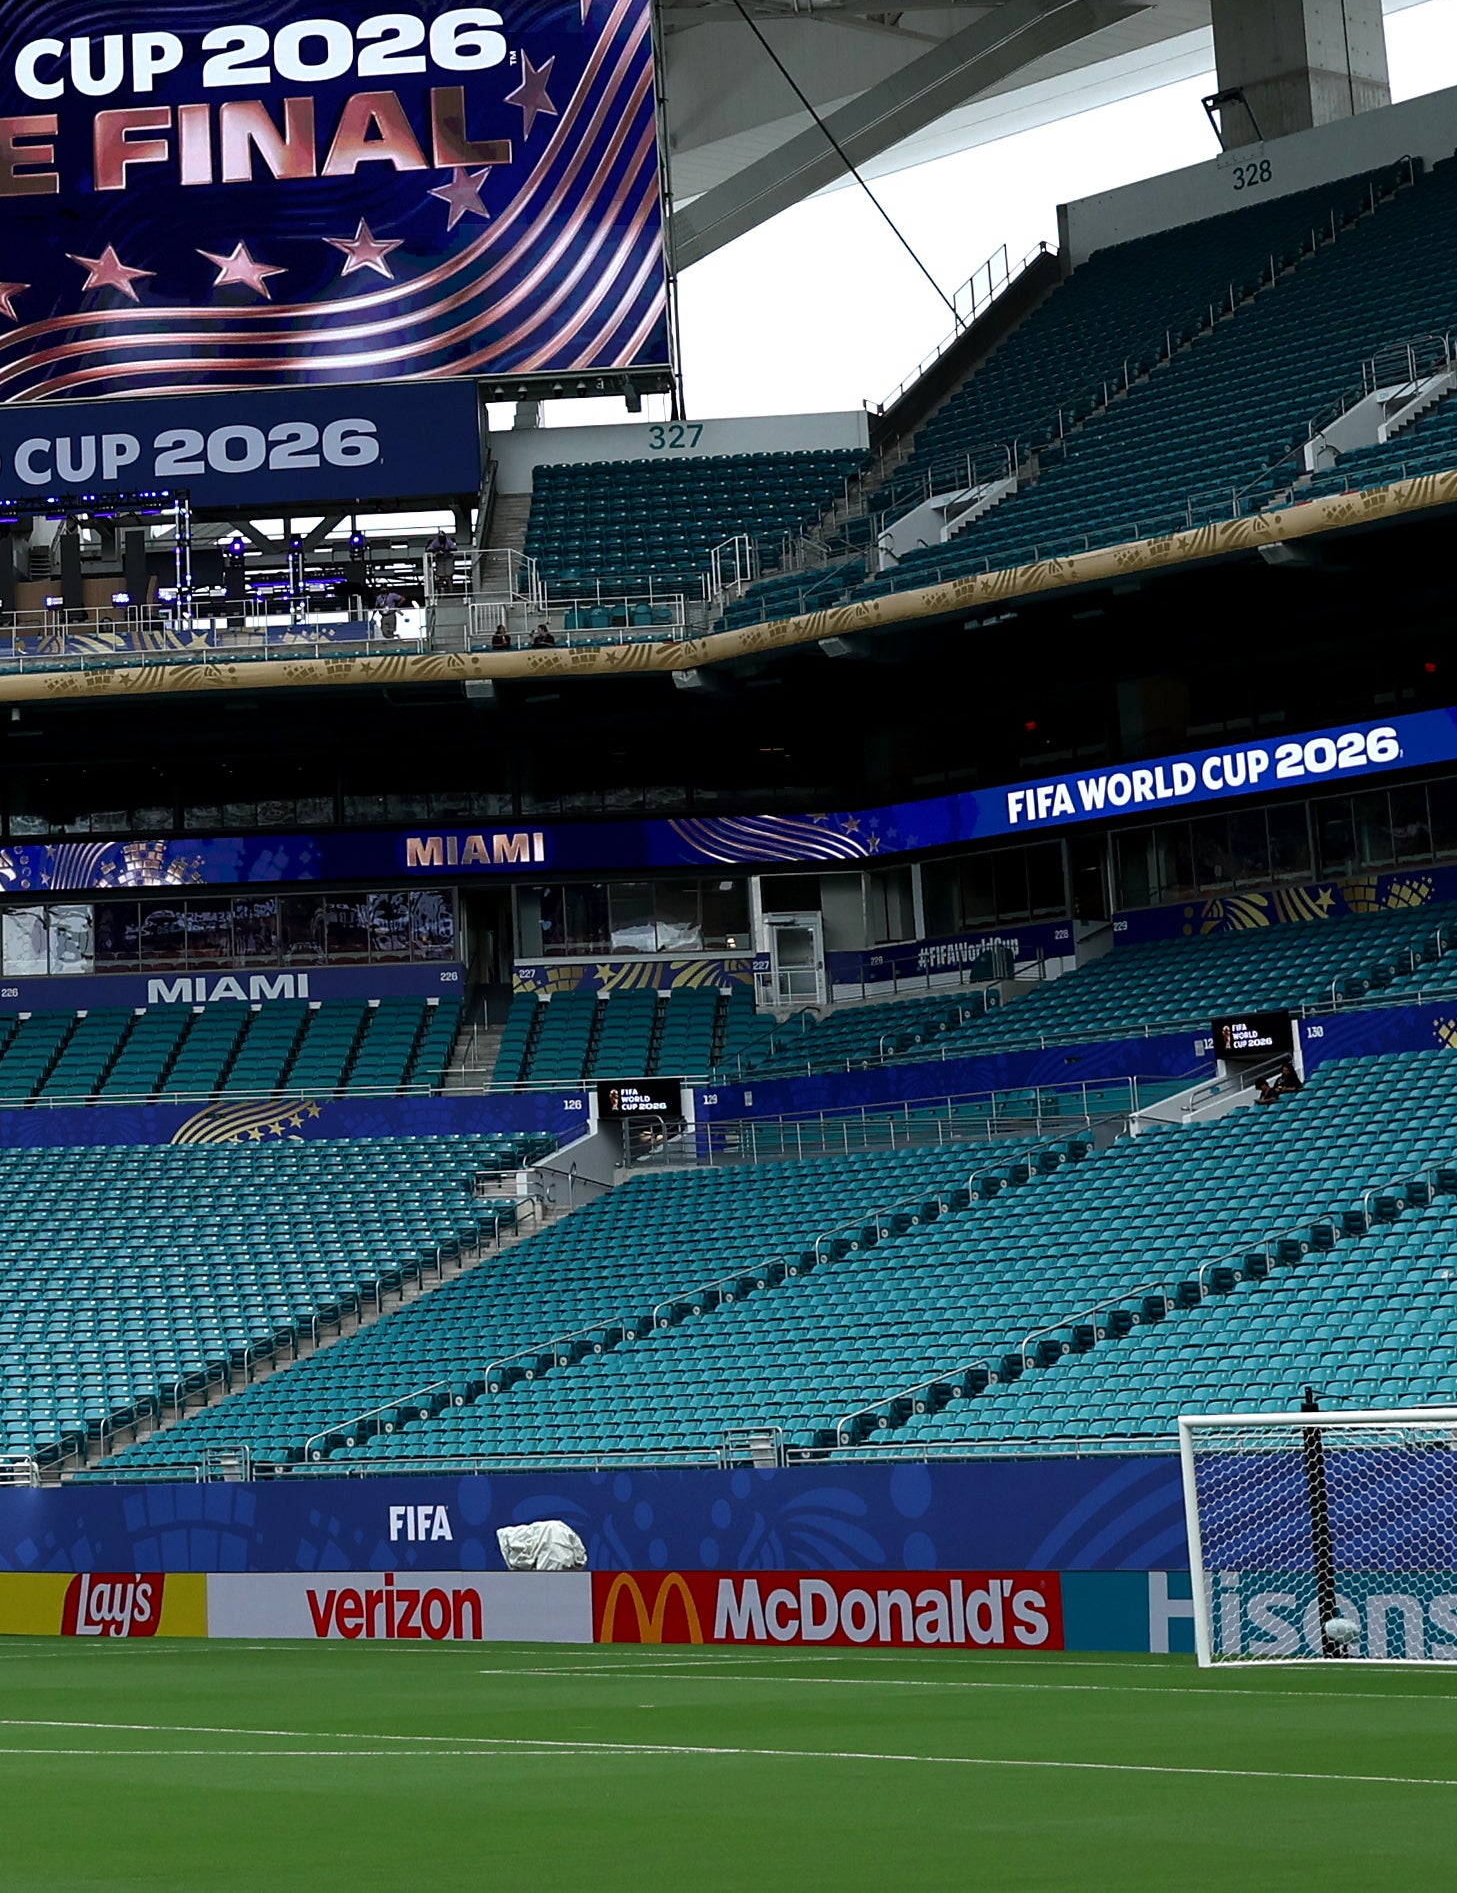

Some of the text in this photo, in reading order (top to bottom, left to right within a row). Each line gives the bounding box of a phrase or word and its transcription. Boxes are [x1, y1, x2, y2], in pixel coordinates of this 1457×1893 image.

[14, 31, 183, 98] CUP
[201, 8, 508, 87] 2026
[94, 85, 512, 191] FINAL
[1232, 160, 1273, 191] 328
[648, 424, 704, 450] 327
[14, 433, 141, 485] CUP
[154, 418, 381, 476] 2026
[1008, 726, 1400, 824] FIFA WORLD CUP 2026
[406, 832, 544, 867] MIAMI
[1054, 929, 1070, 940] 228
[440, 971, 458, 982] 226
[519, 968, 536, 980] 227
[752, 960, 770, 971] 227
[1, 987, 19, 998] 226
[147, 973, 309, 1003] MIAMI
[1232, 1023, 1247, 1032] FIFA
[1232, 1030, 1259, 1040] WORLD
[1307, 1026, 1324, 1038] 130
[1203, 1038, 1215, 1050] 12
[621, 1088, 639, 1096] FIFA
[621, 1095, 651, 1103] WORLD
[389, 1506, 453, 1541] FIFA
[75, 1572, 152, 1637] Lay's
[306, 1573, 483, 1641] verizon
[714, 1578, 1050, 1646] McDonald's
